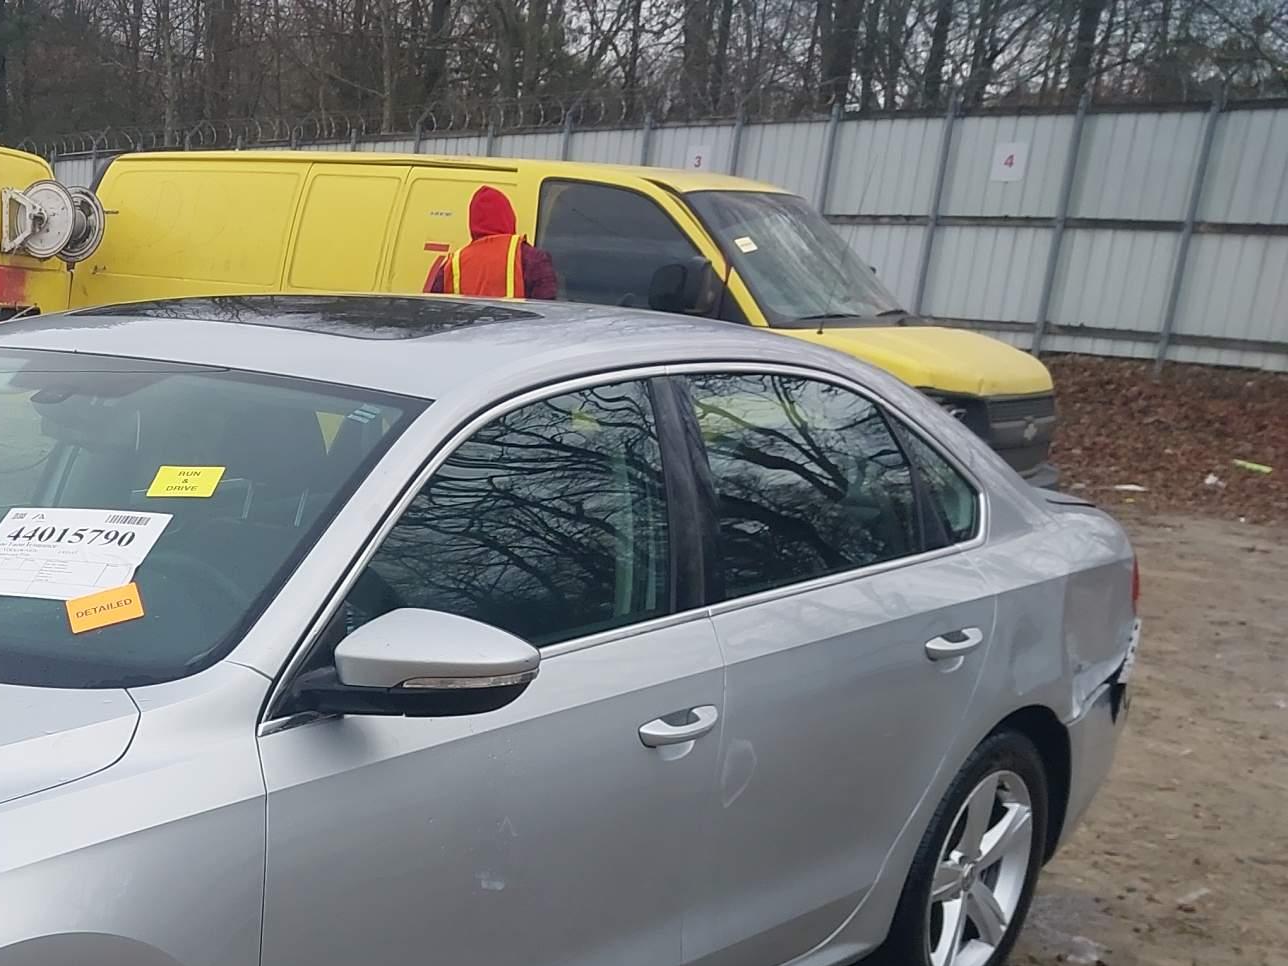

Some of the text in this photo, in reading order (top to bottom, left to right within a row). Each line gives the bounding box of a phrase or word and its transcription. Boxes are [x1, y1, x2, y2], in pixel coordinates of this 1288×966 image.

[694, 155, 703, 168] 3
[1003, 154, 1015, 168] 4
[6, 525, 136, 547] 44015790
[75, 598, 133, 619] DETAILED
